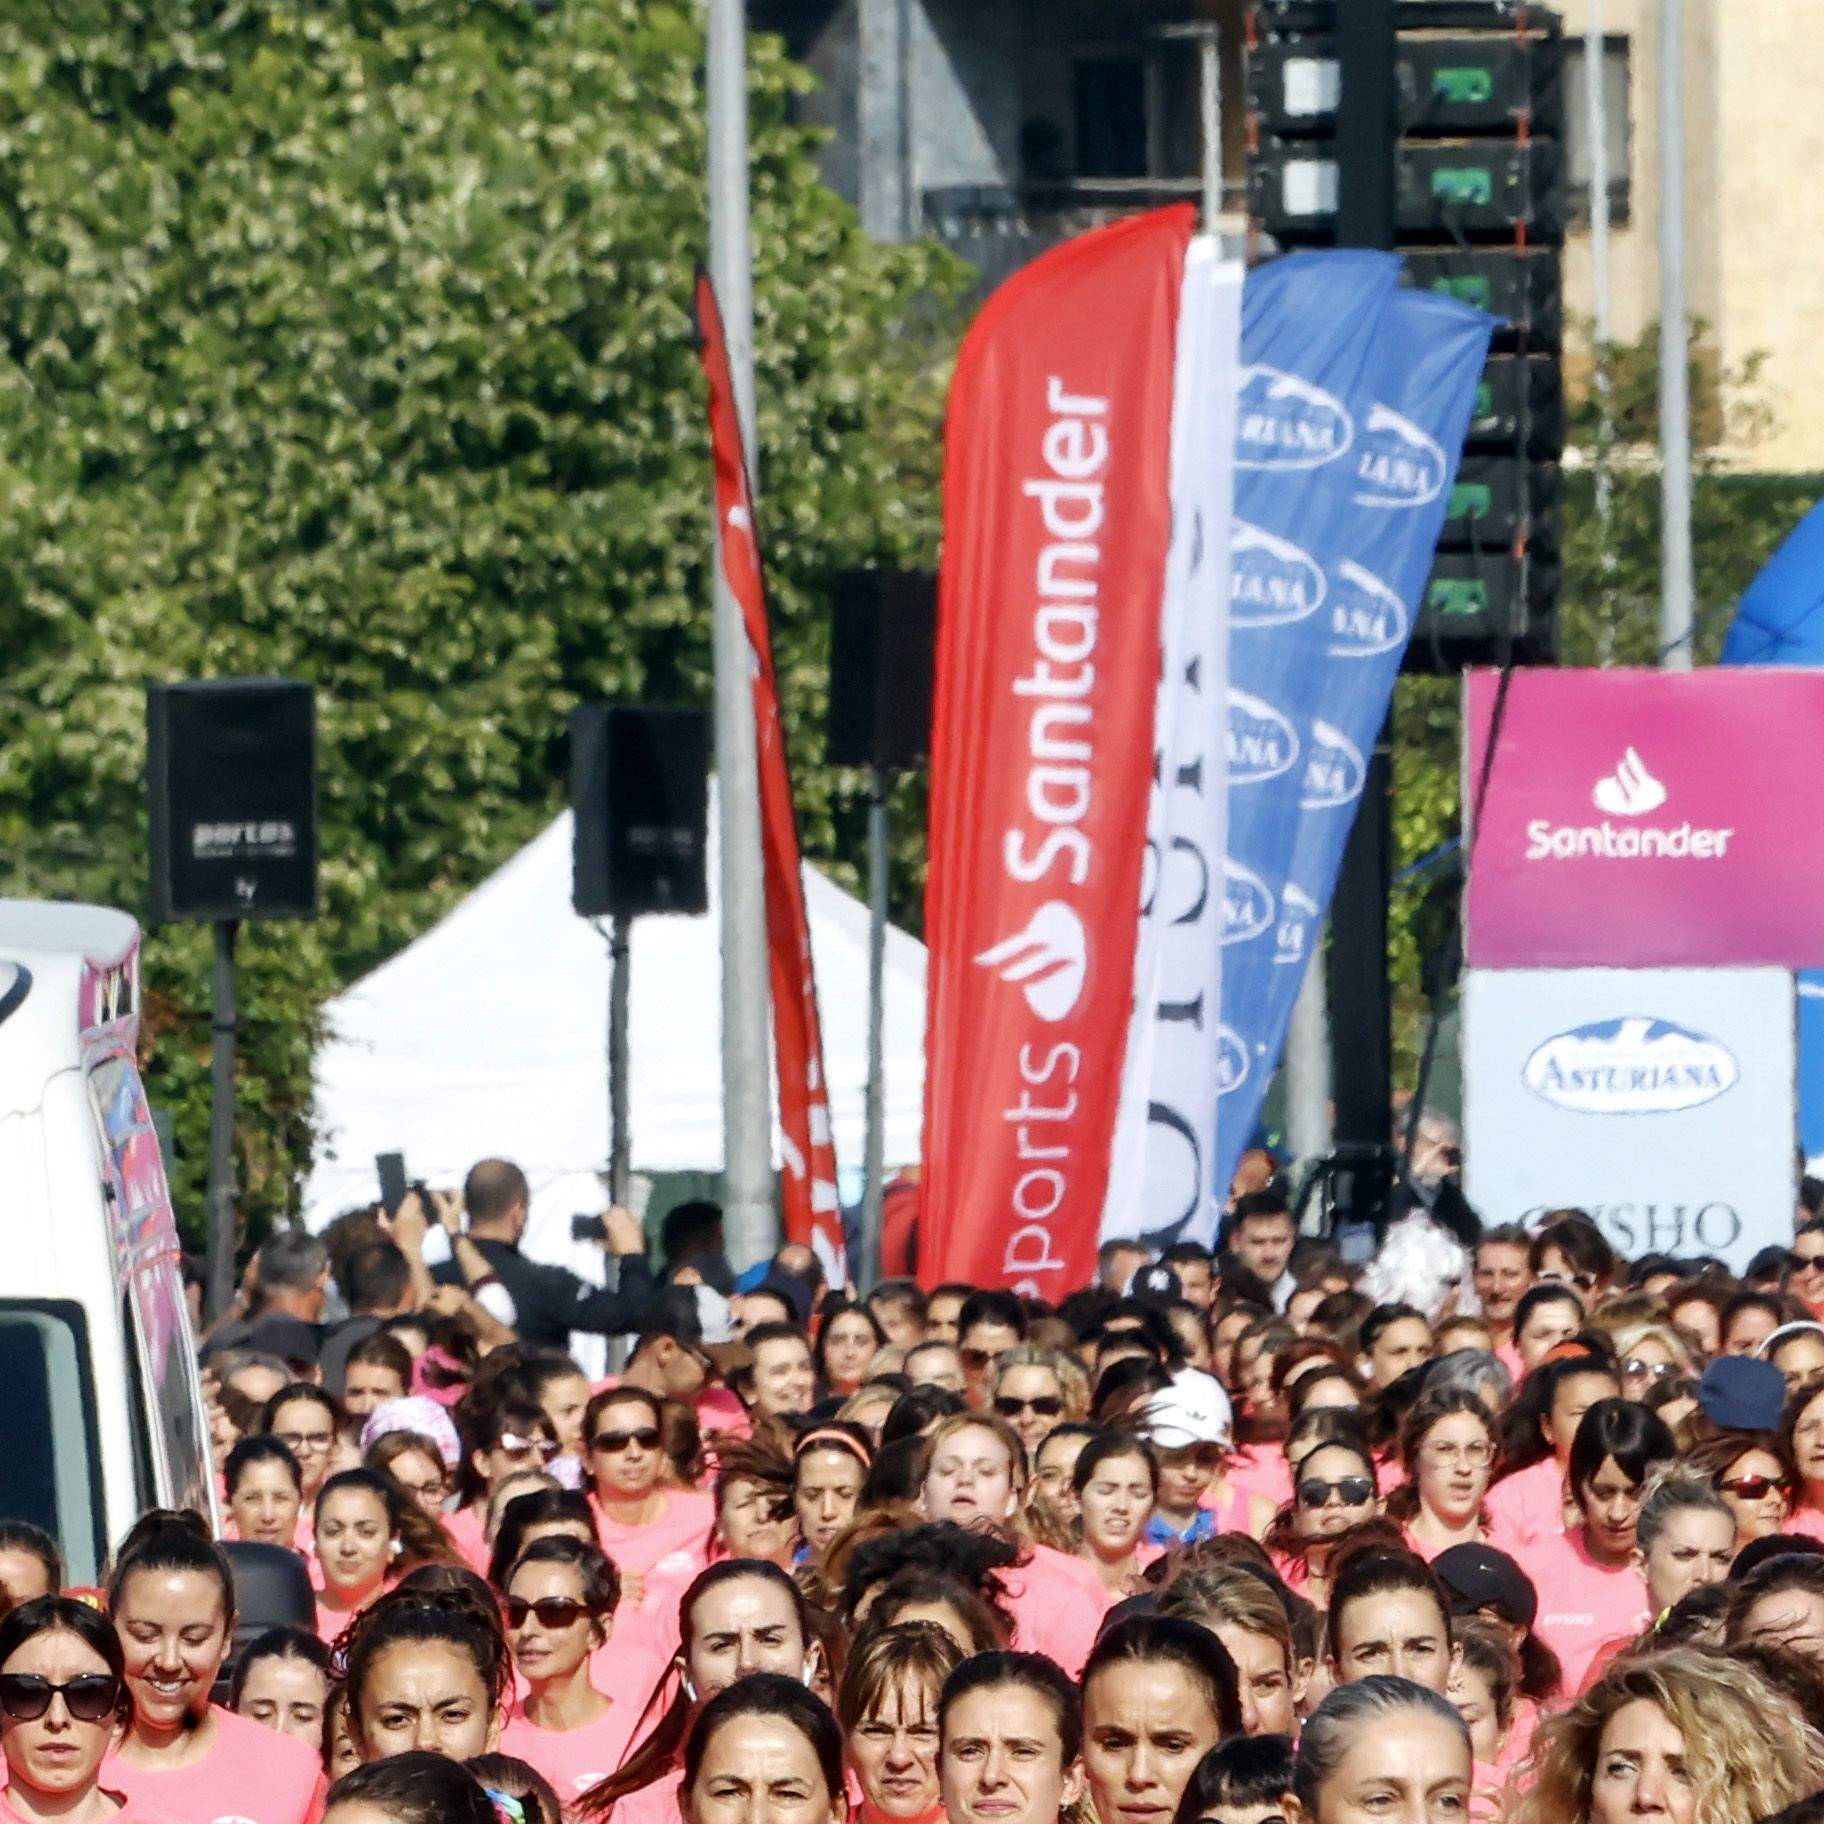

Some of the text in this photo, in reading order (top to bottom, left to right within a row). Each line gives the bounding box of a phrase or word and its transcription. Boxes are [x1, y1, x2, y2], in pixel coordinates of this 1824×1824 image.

[1003, 376, 1109, 886] Santander
[1524, 817, 1734, 861] Santander
[1542, 1055, 1723, 1096] ASTURIANA
